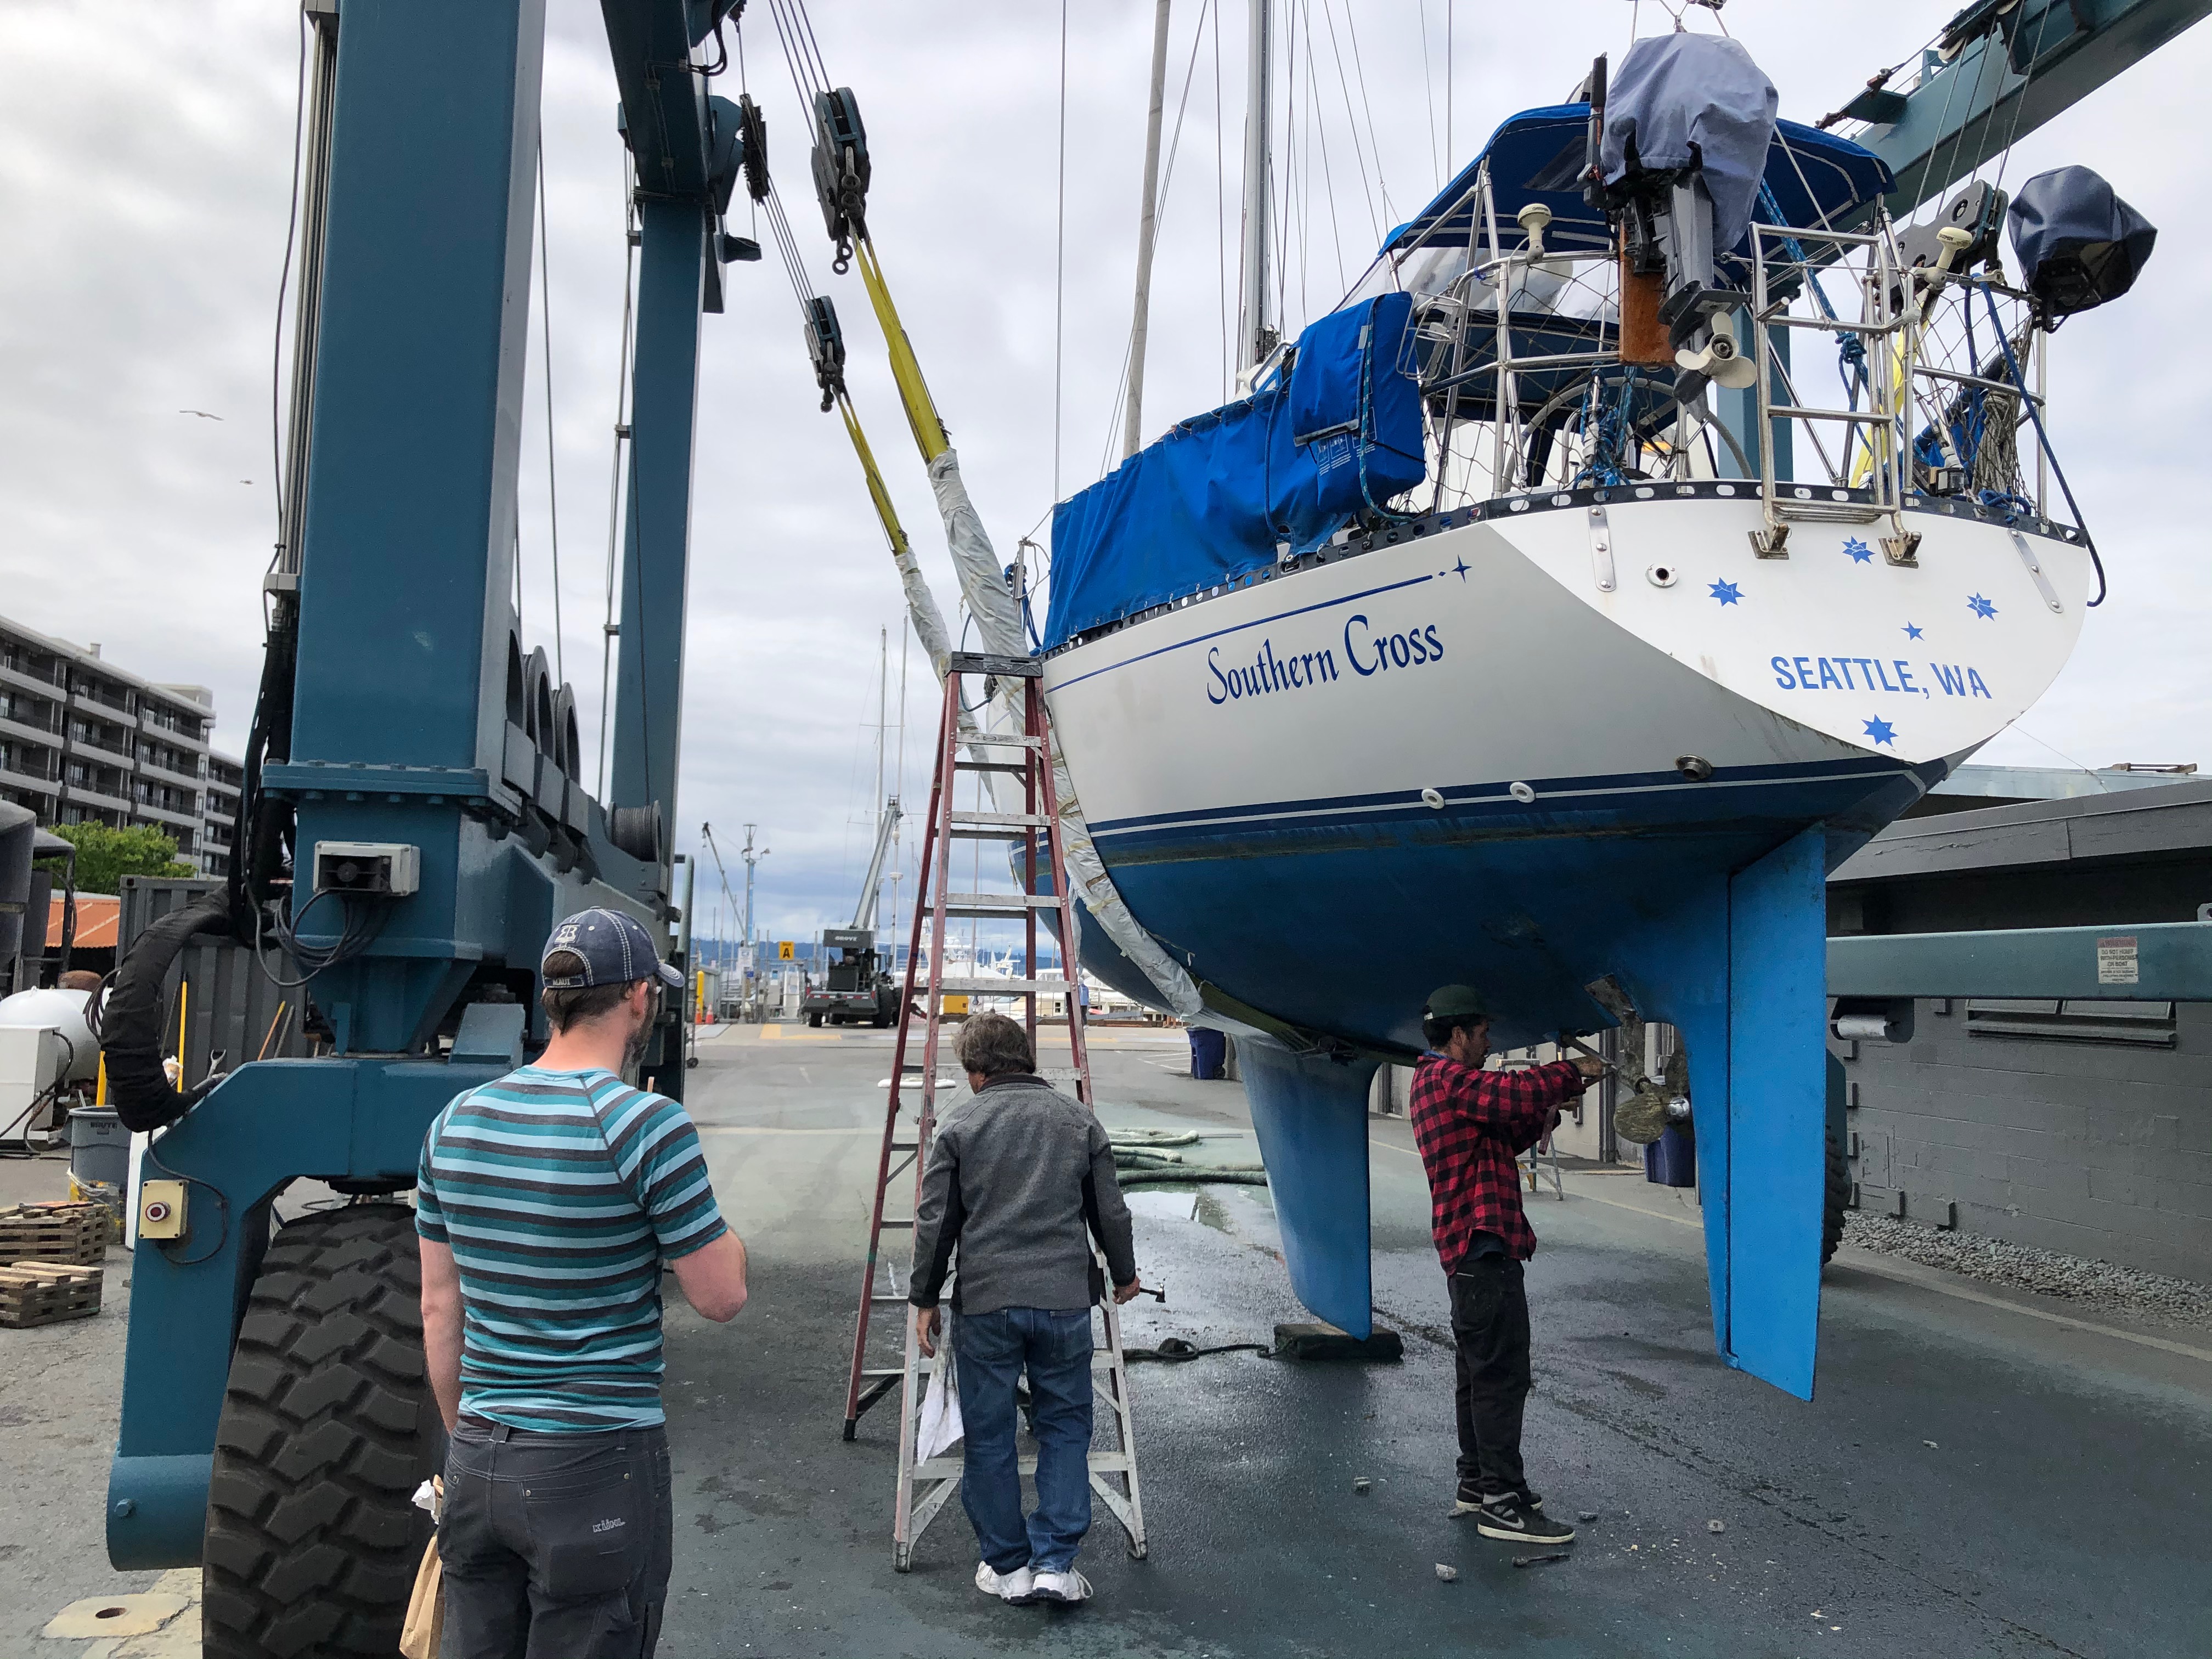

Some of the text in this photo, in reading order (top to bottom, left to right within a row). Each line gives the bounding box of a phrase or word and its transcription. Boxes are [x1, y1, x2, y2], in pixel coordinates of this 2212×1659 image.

[1207, 614, 1443, 704] Southern Cross
[1770, 656, 1993, 700] SEATTLE, WA
[782, 947, 791, 958] A
[552, 978, 571, 986] MAUI
[592, 1517, 626, 1533] KÜHL
